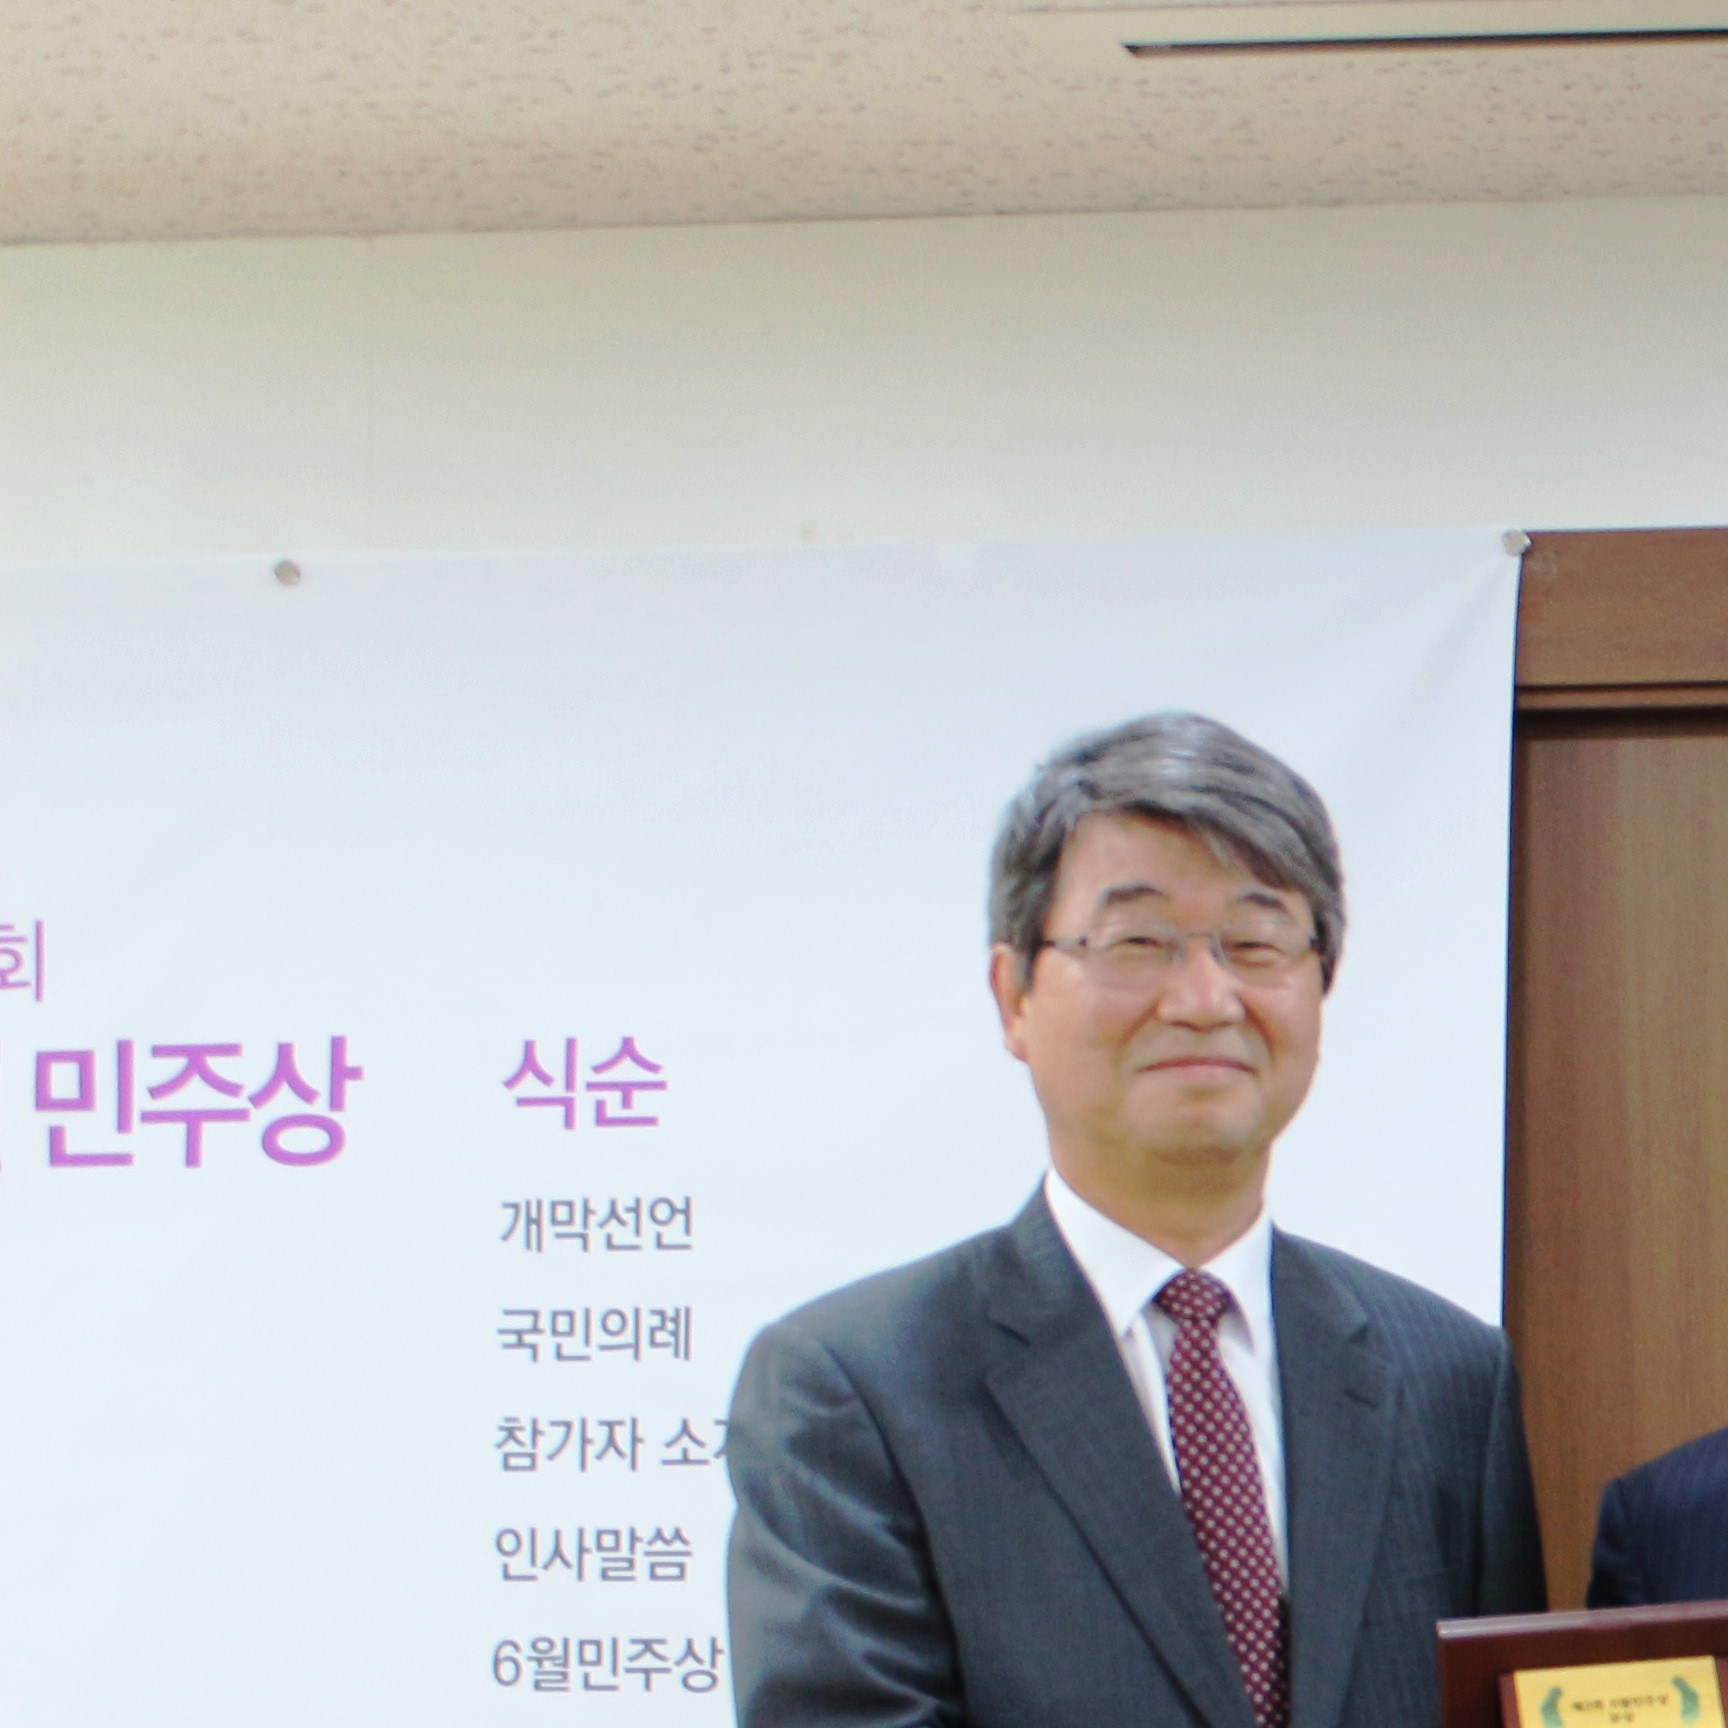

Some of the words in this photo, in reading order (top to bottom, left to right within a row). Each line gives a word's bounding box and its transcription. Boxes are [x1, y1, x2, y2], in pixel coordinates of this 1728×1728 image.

[0, 919, 44, 1002] 회
[33, 1035, 363, 1169] 민주상
[502, 1036, 668, 1131] 식순
[500, 1195, 693, 1253] 개막선언
[496, 1305, 692, 1363] 국민의례
[494, 1416, 645, 1473] 참가자
[494, 1526, 693, 1582] 인사말씀
[492, 1636, 725, 1694] 6월민주상
